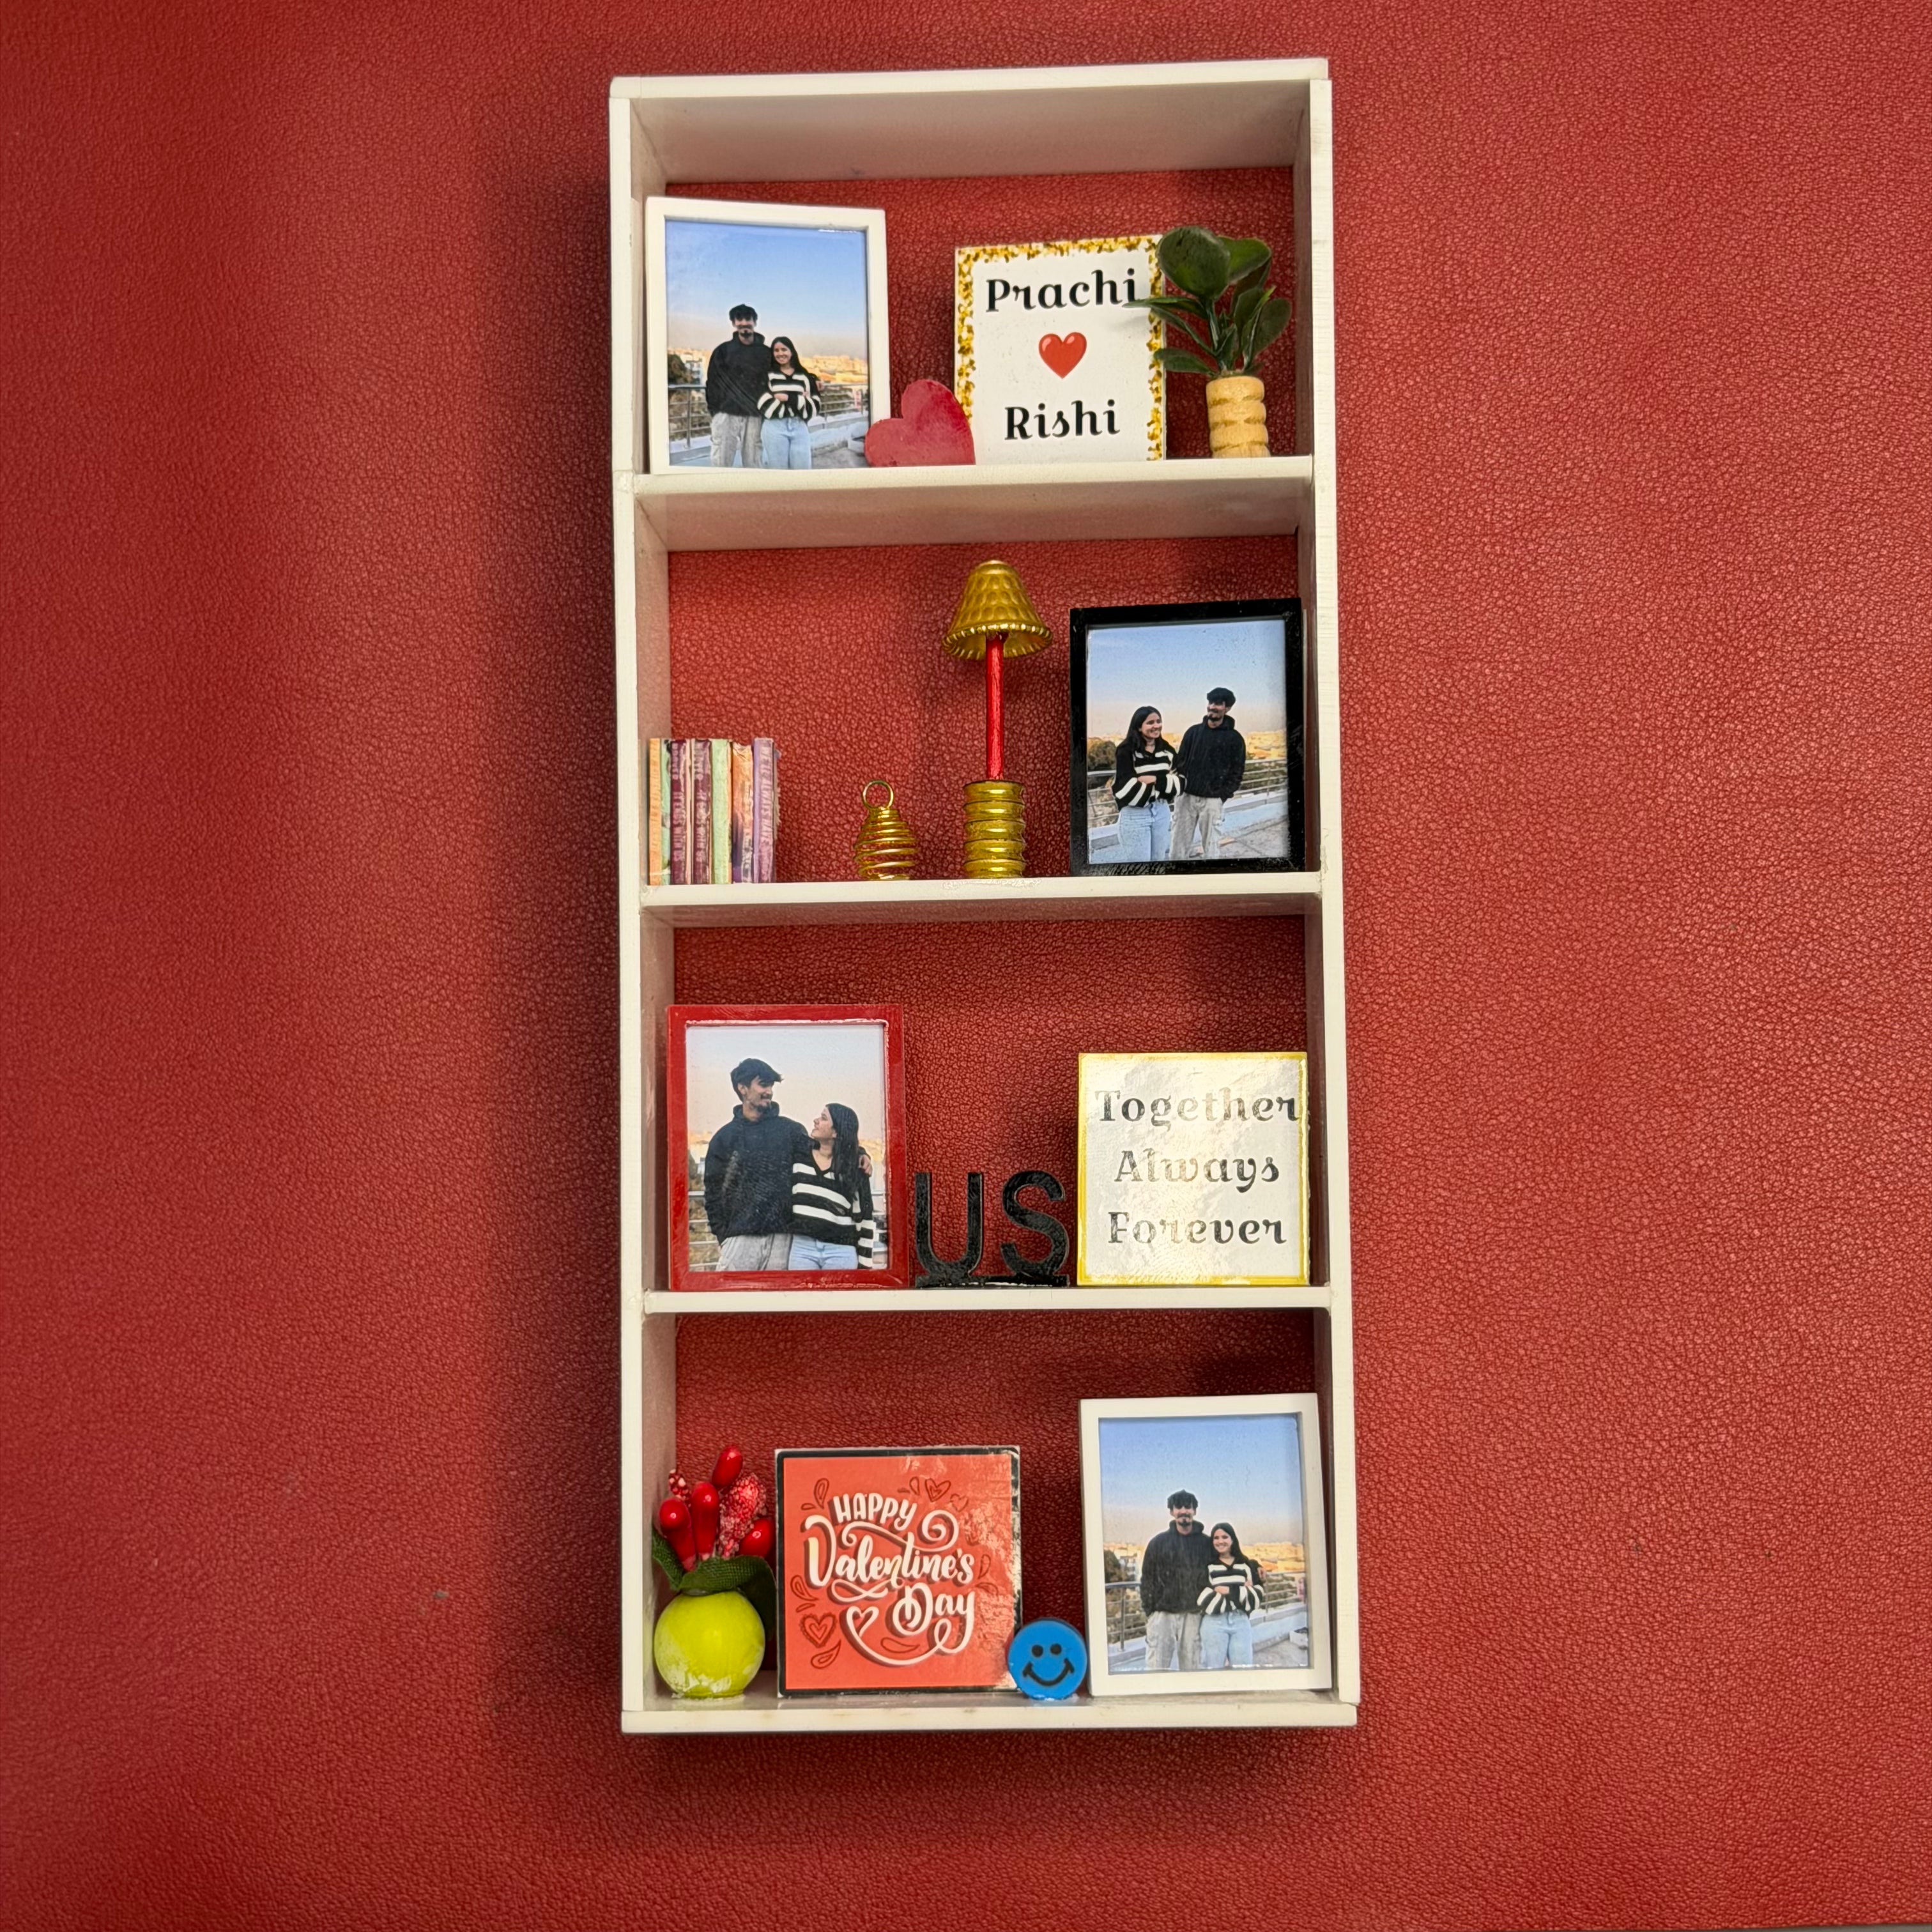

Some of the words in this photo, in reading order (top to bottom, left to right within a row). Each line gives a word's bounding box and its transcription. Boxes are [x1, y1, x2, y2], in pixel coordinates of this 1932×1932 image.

[985, 268, 1141, 312] Prachi
[1004, 399, 1121, 441] Rishi
[1095, 1087, 1300, 1132] Together
[1114, 1148, 1279, 1193] Always
[915, 1170, 1070, 1277] US
[1108, 1211, 1287, 1245] Forever
[832, 1492, 917, 1531] HAPPY
[805, 1512, 975, 1591] Valentine's
[894, 1583, 976, 1653] Day
